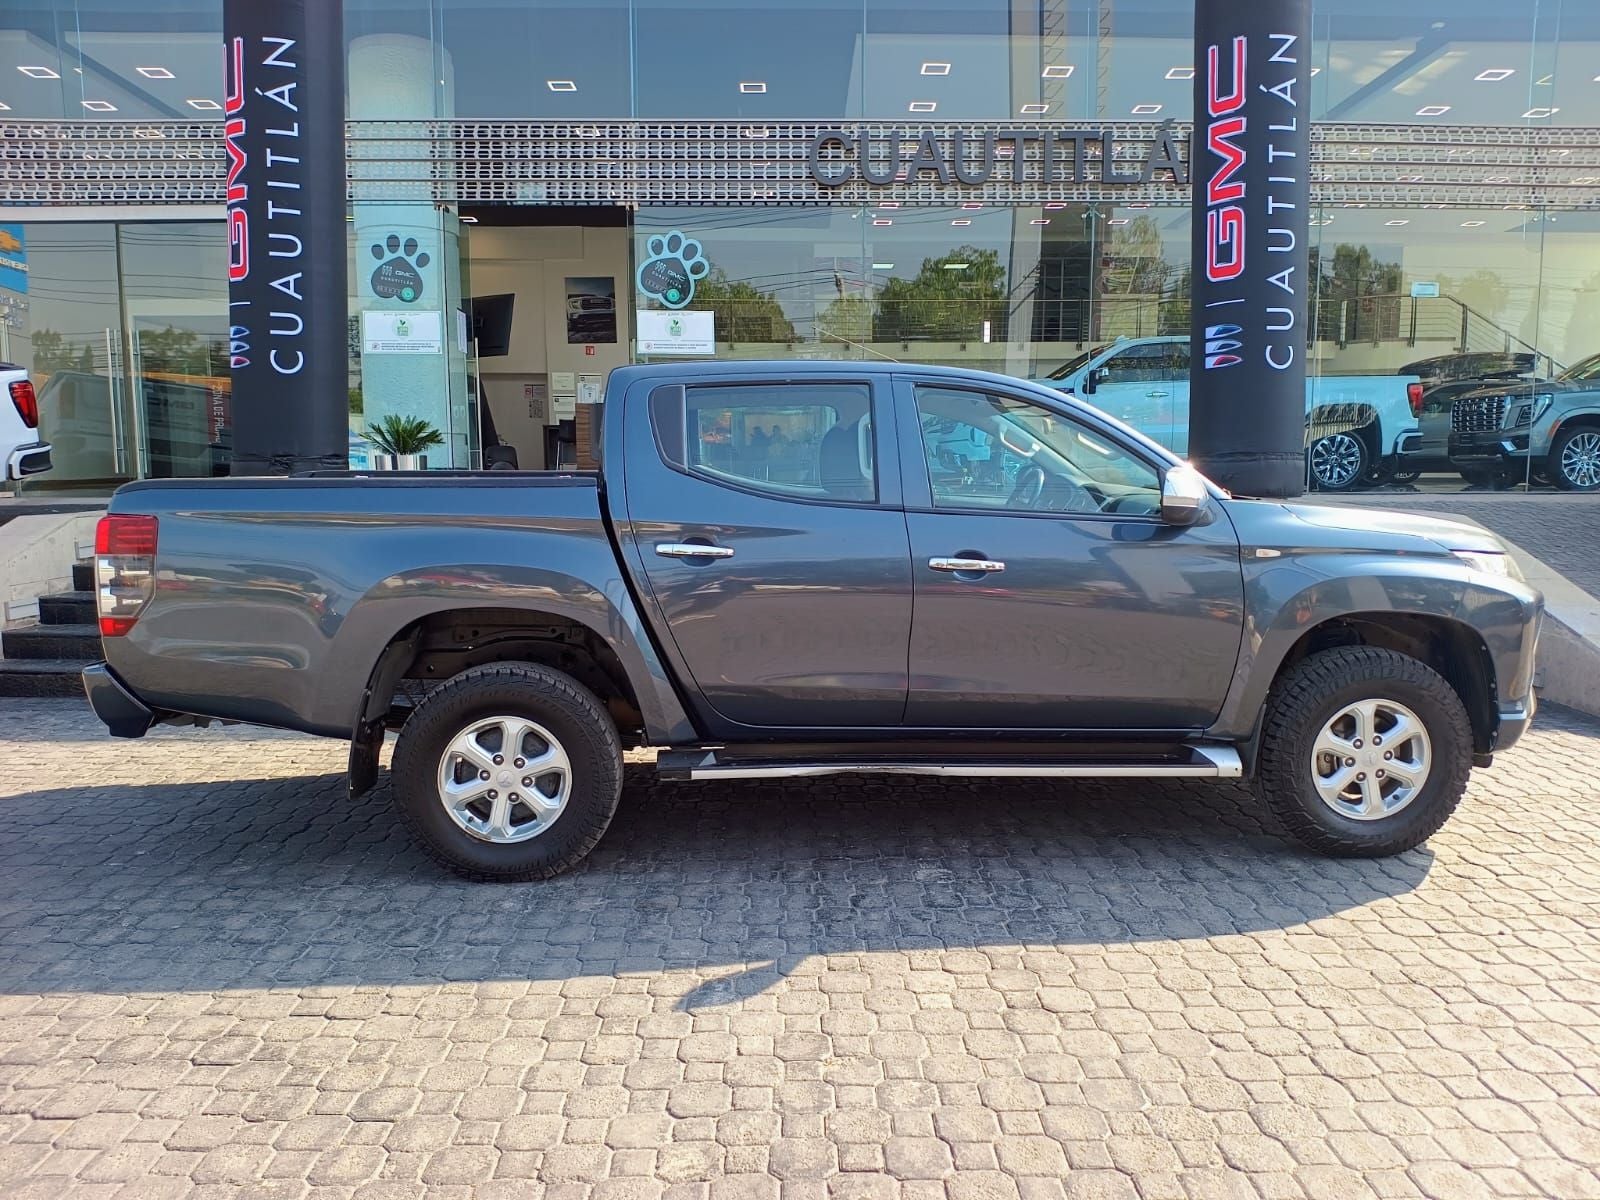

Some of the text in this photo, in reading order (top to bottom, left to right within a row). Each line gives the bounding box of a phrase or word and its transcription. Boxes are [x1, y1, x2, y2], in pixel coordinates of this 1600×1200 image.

[223, 36, 248, 282] GMC
[255, 36, 304, 375] CUAUTITLÁN
[809, 118, 1193, 186] CUAUTITLÁ
[1206, 35, 1247, 283] GMC
[1259, 33, 1298, 370] CUAUTITLÁN
[213, 406, 224, 416] DE
